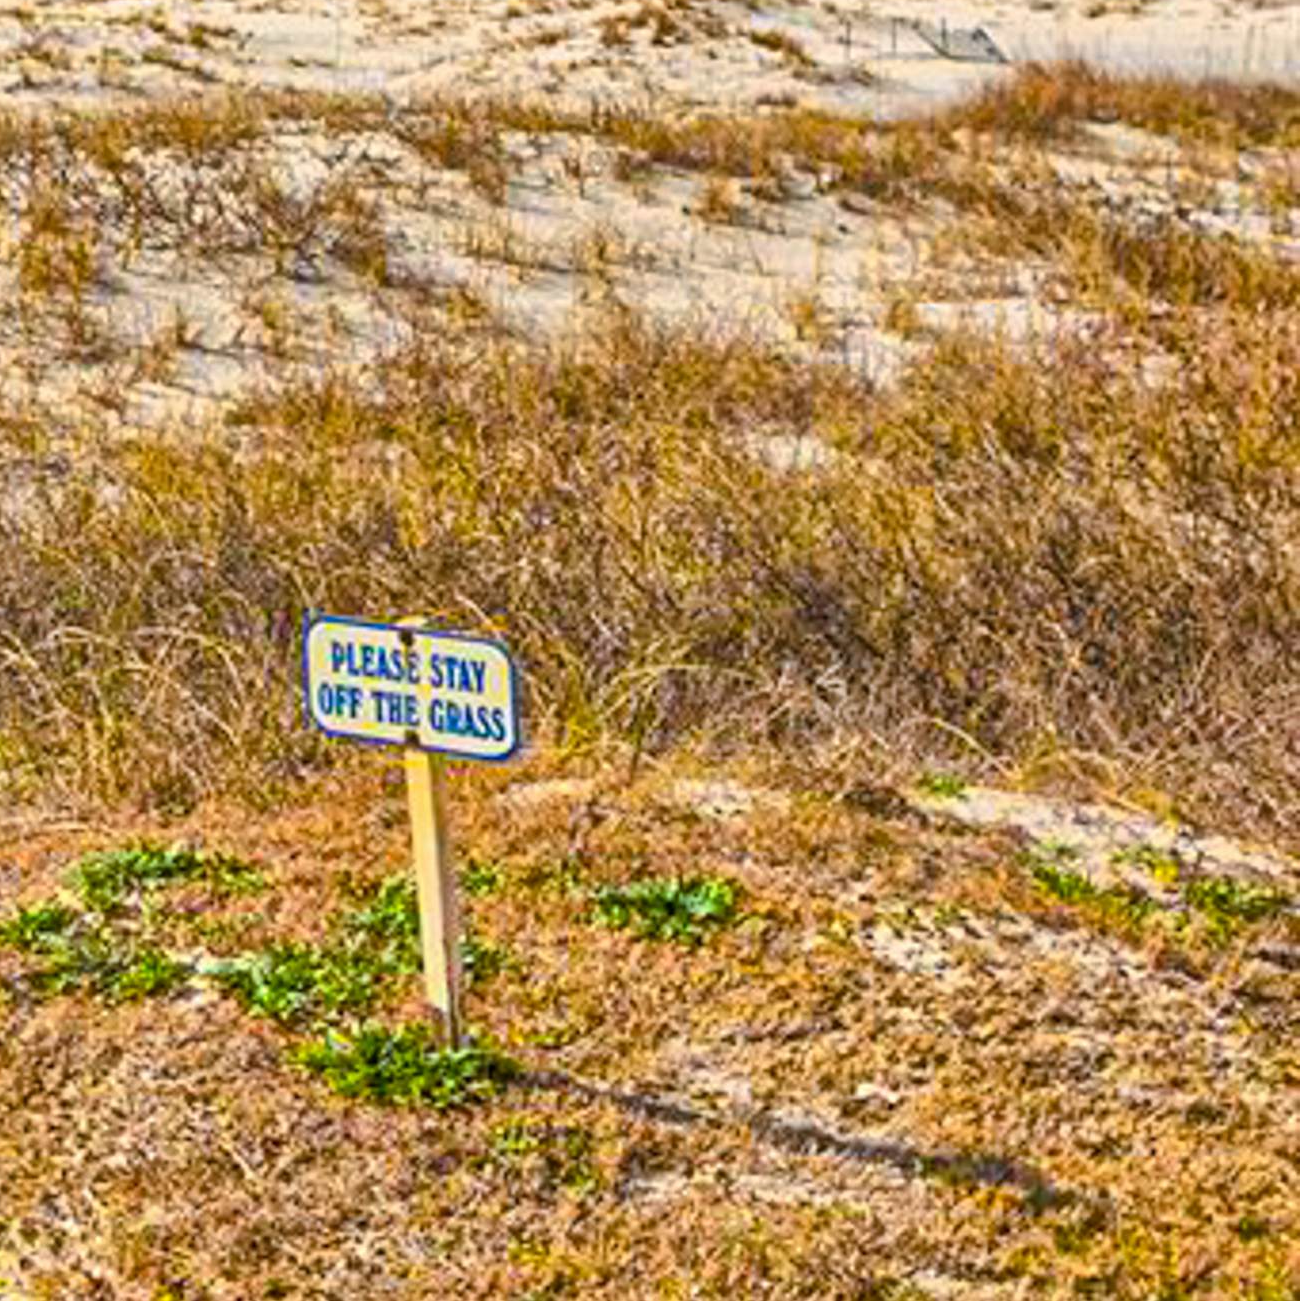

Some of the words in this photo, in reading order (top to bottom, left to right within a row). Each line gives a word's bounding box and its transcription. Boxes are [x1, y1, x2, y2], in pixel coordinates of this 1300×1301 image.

[330, 640, 421, 685] PLEASE
[429, 653, 487, 694] STAY
[317, 682, 364, 719] OFF
[370, 691, 421, 727] THE
[429, 698, 507, 742] GRASS
